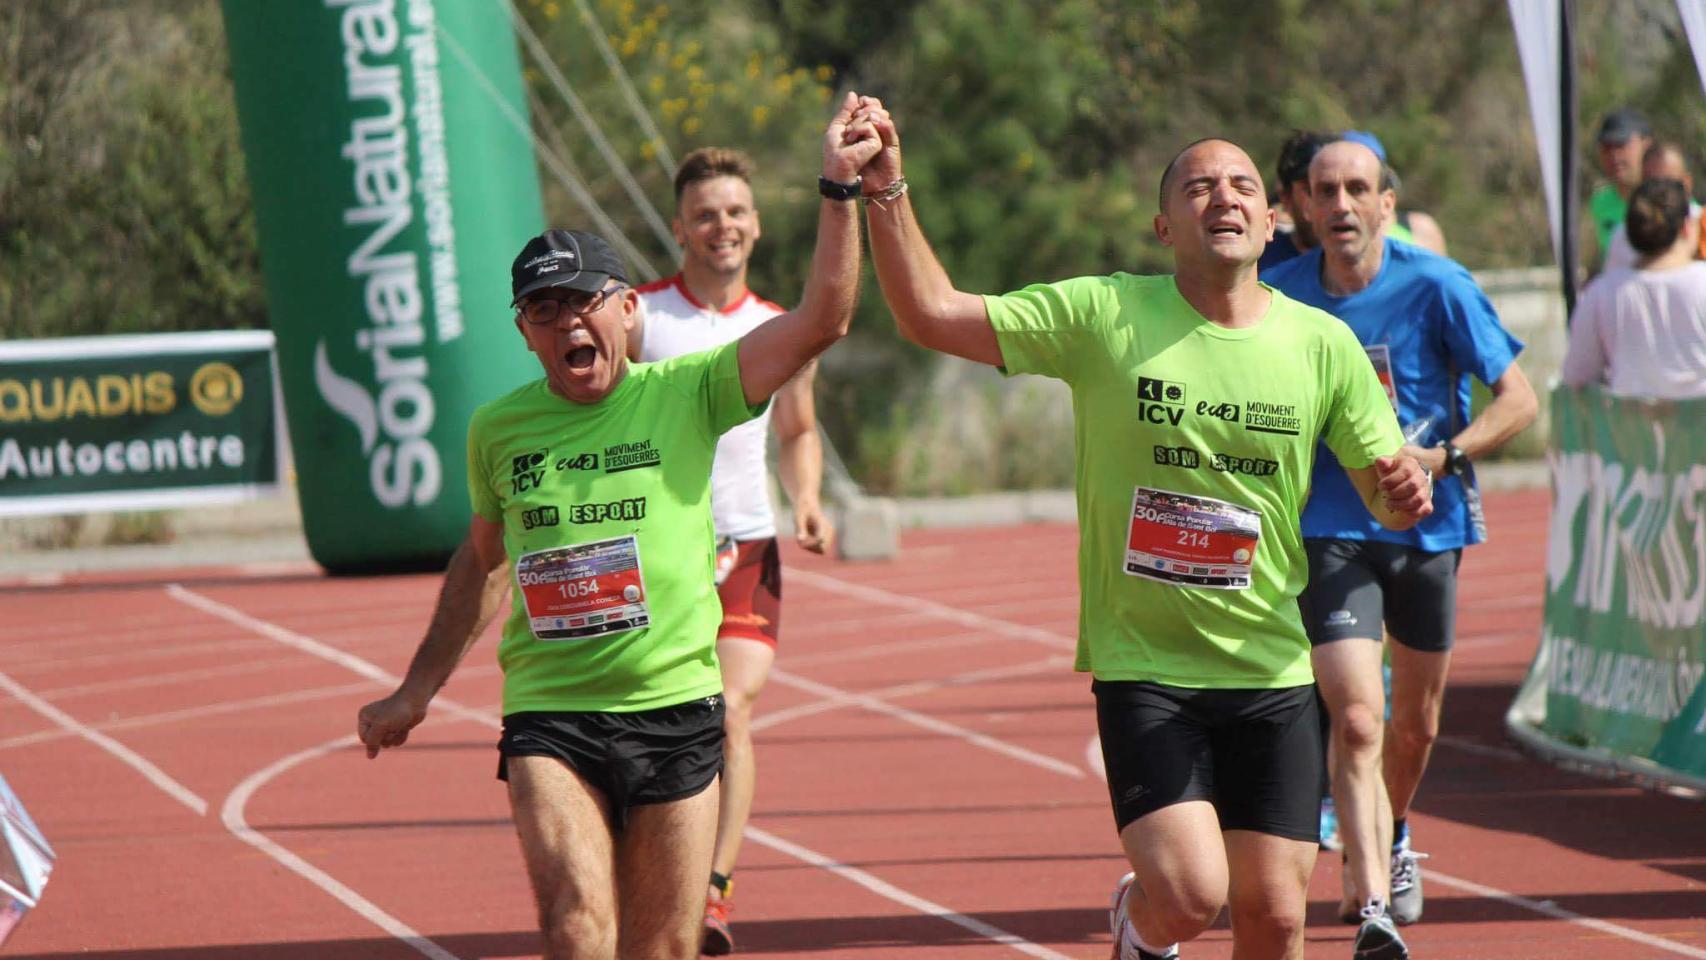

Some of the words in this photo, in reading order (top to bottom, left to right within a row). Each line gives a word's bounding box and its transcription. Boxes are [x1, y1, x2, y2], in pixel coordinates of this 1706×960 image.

[323, 0, 442, 508] SoriaNatural
[0, 371, 177, 423] QUADIS
[1138, 401, 1185, 427] ICV
[1246, 401, 1296, 417] MOVIMENT
[1245, 412, 1301, 431] D'ESQUERRES
[0, 430, 245, 480] Autocentre
[604, 439, 651, 458] MOVIMENT
[604, 448, 661, 469] D'ESQUERRES
[1154, 446, 1199, 468] SOM
[511, 470, 546, 496] ICV
[522, 505, 559, 530] SOM
[569, 497, 646, 524] ESPORT
[1176, 530, 1210, 549] 214
[559, 579, 600, 599] 1054
